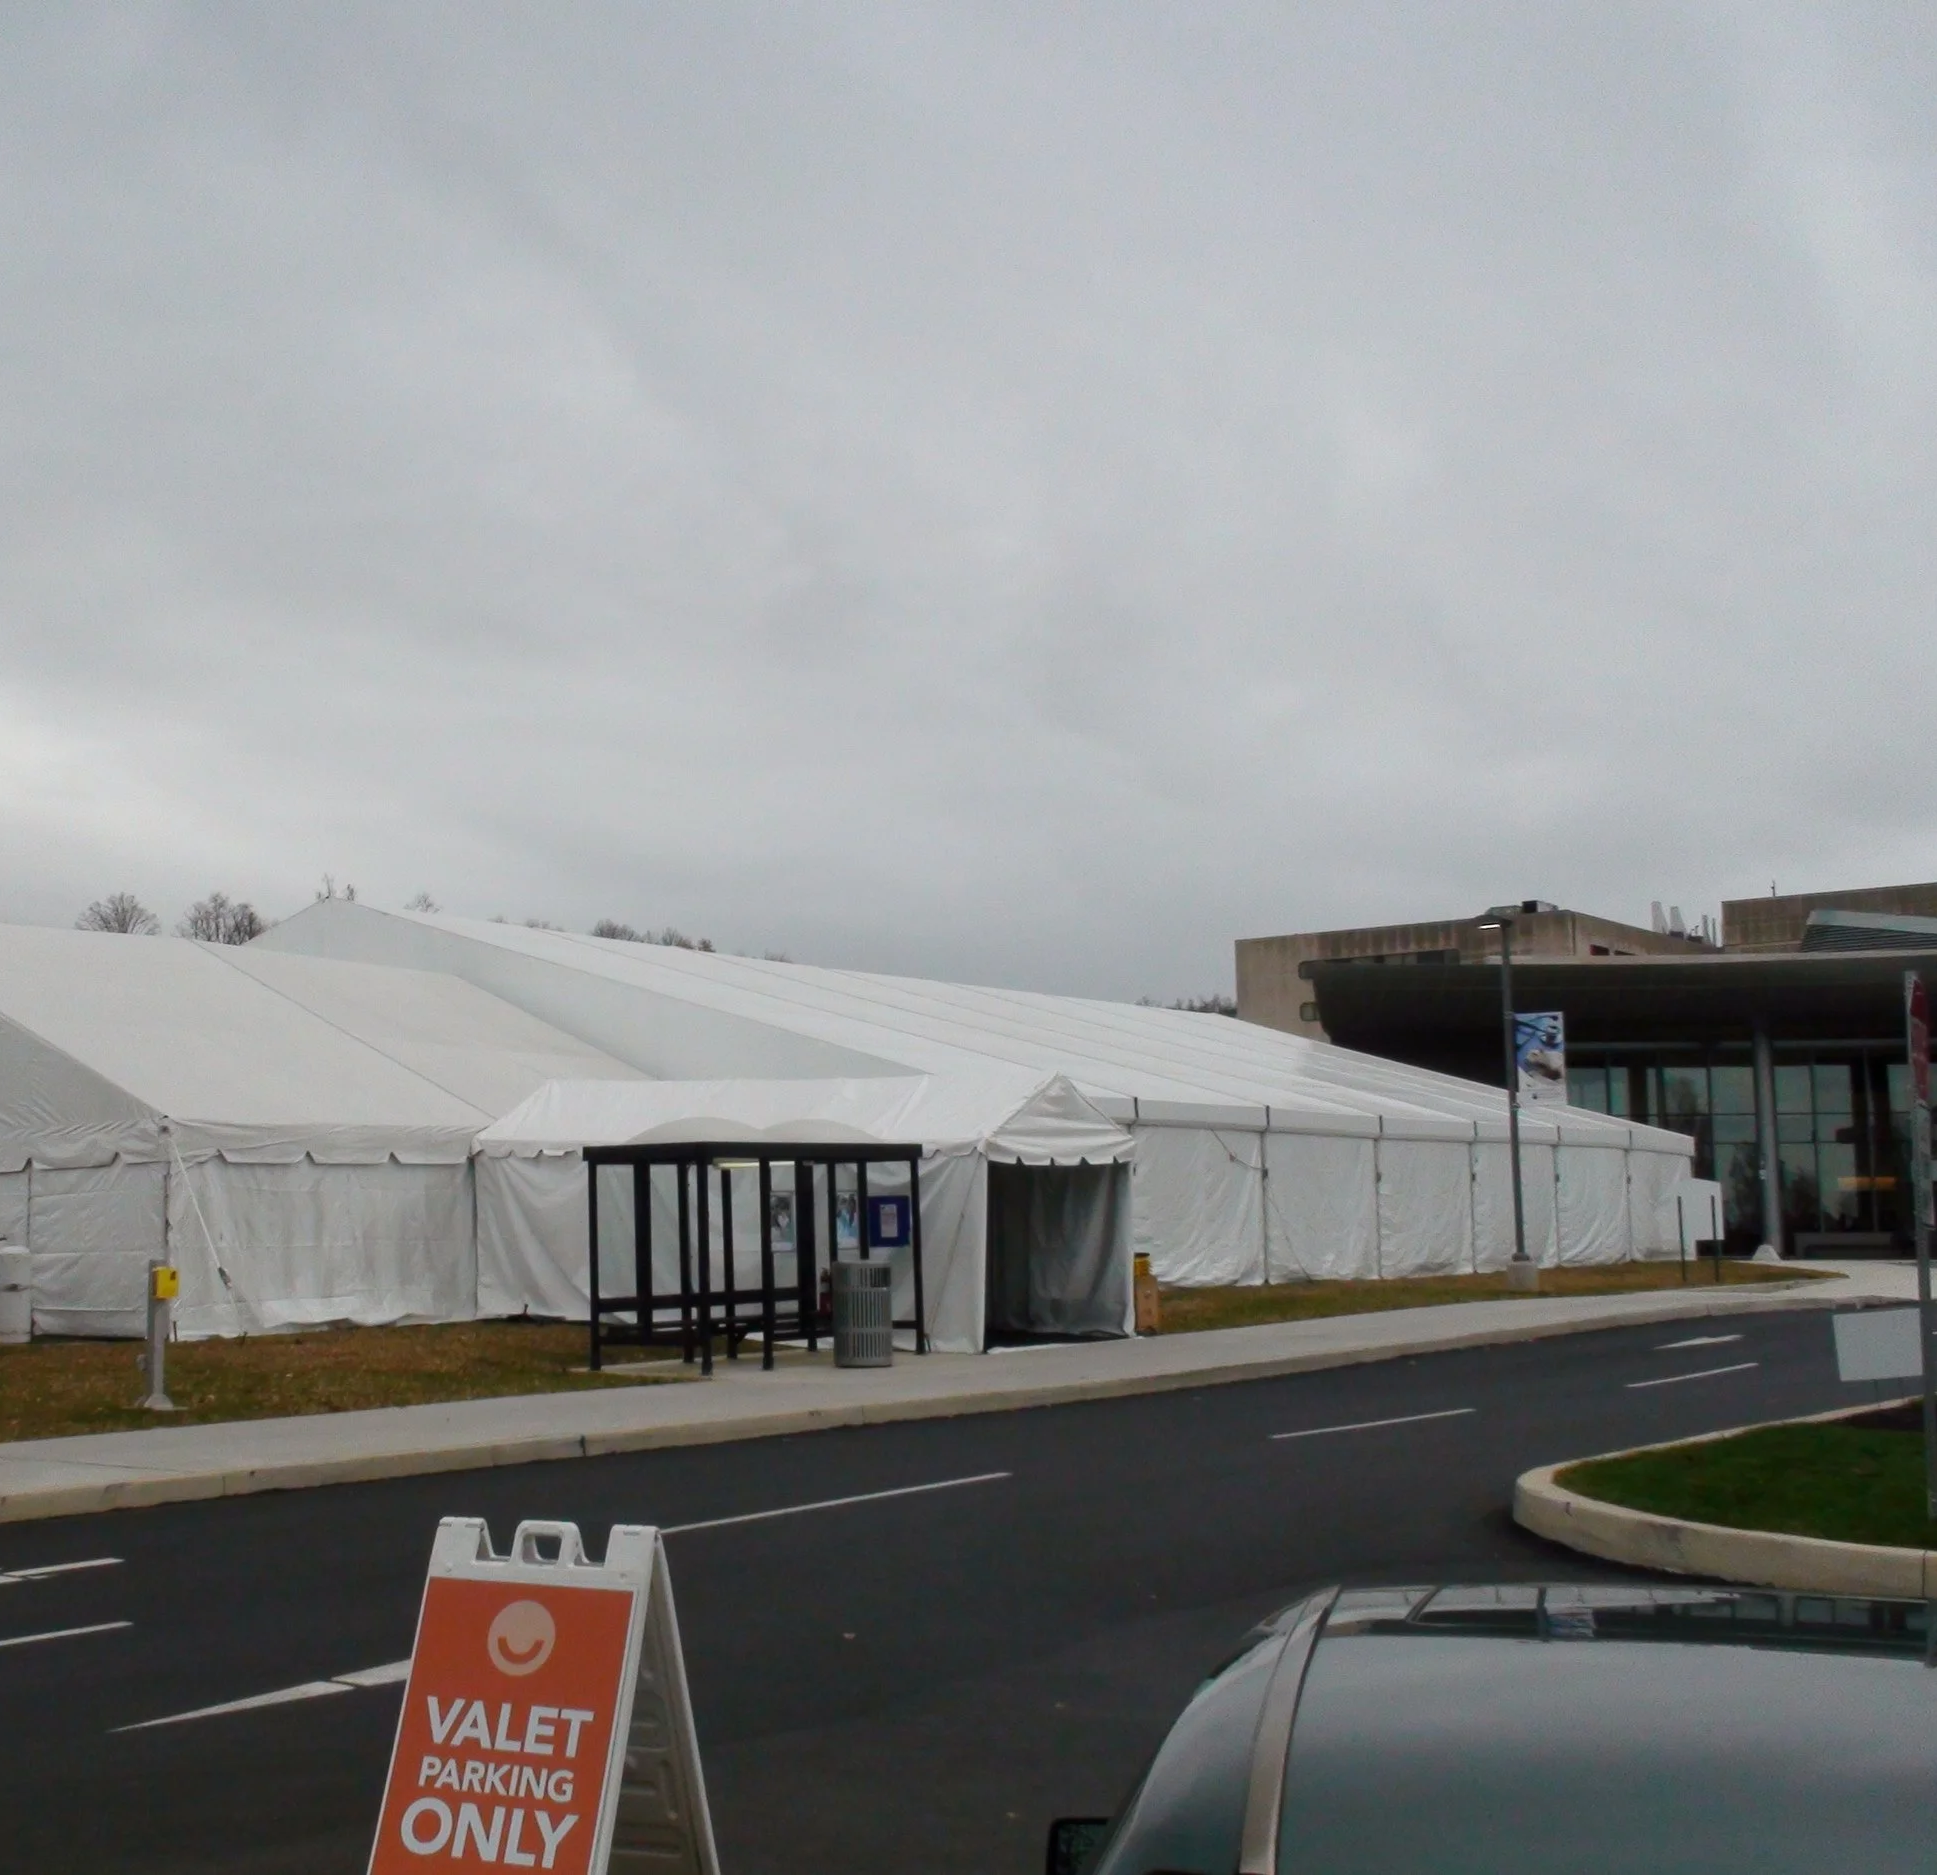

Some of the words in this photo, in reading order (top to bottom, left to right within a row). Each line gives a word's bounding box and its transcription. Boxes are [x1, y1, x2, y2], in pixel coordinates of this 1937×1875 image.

[427, 1696, 594, 1758] VALET
[418, 1756, 574, 1803] PARKING
[401, 1797, 578, 1869] ONLY
